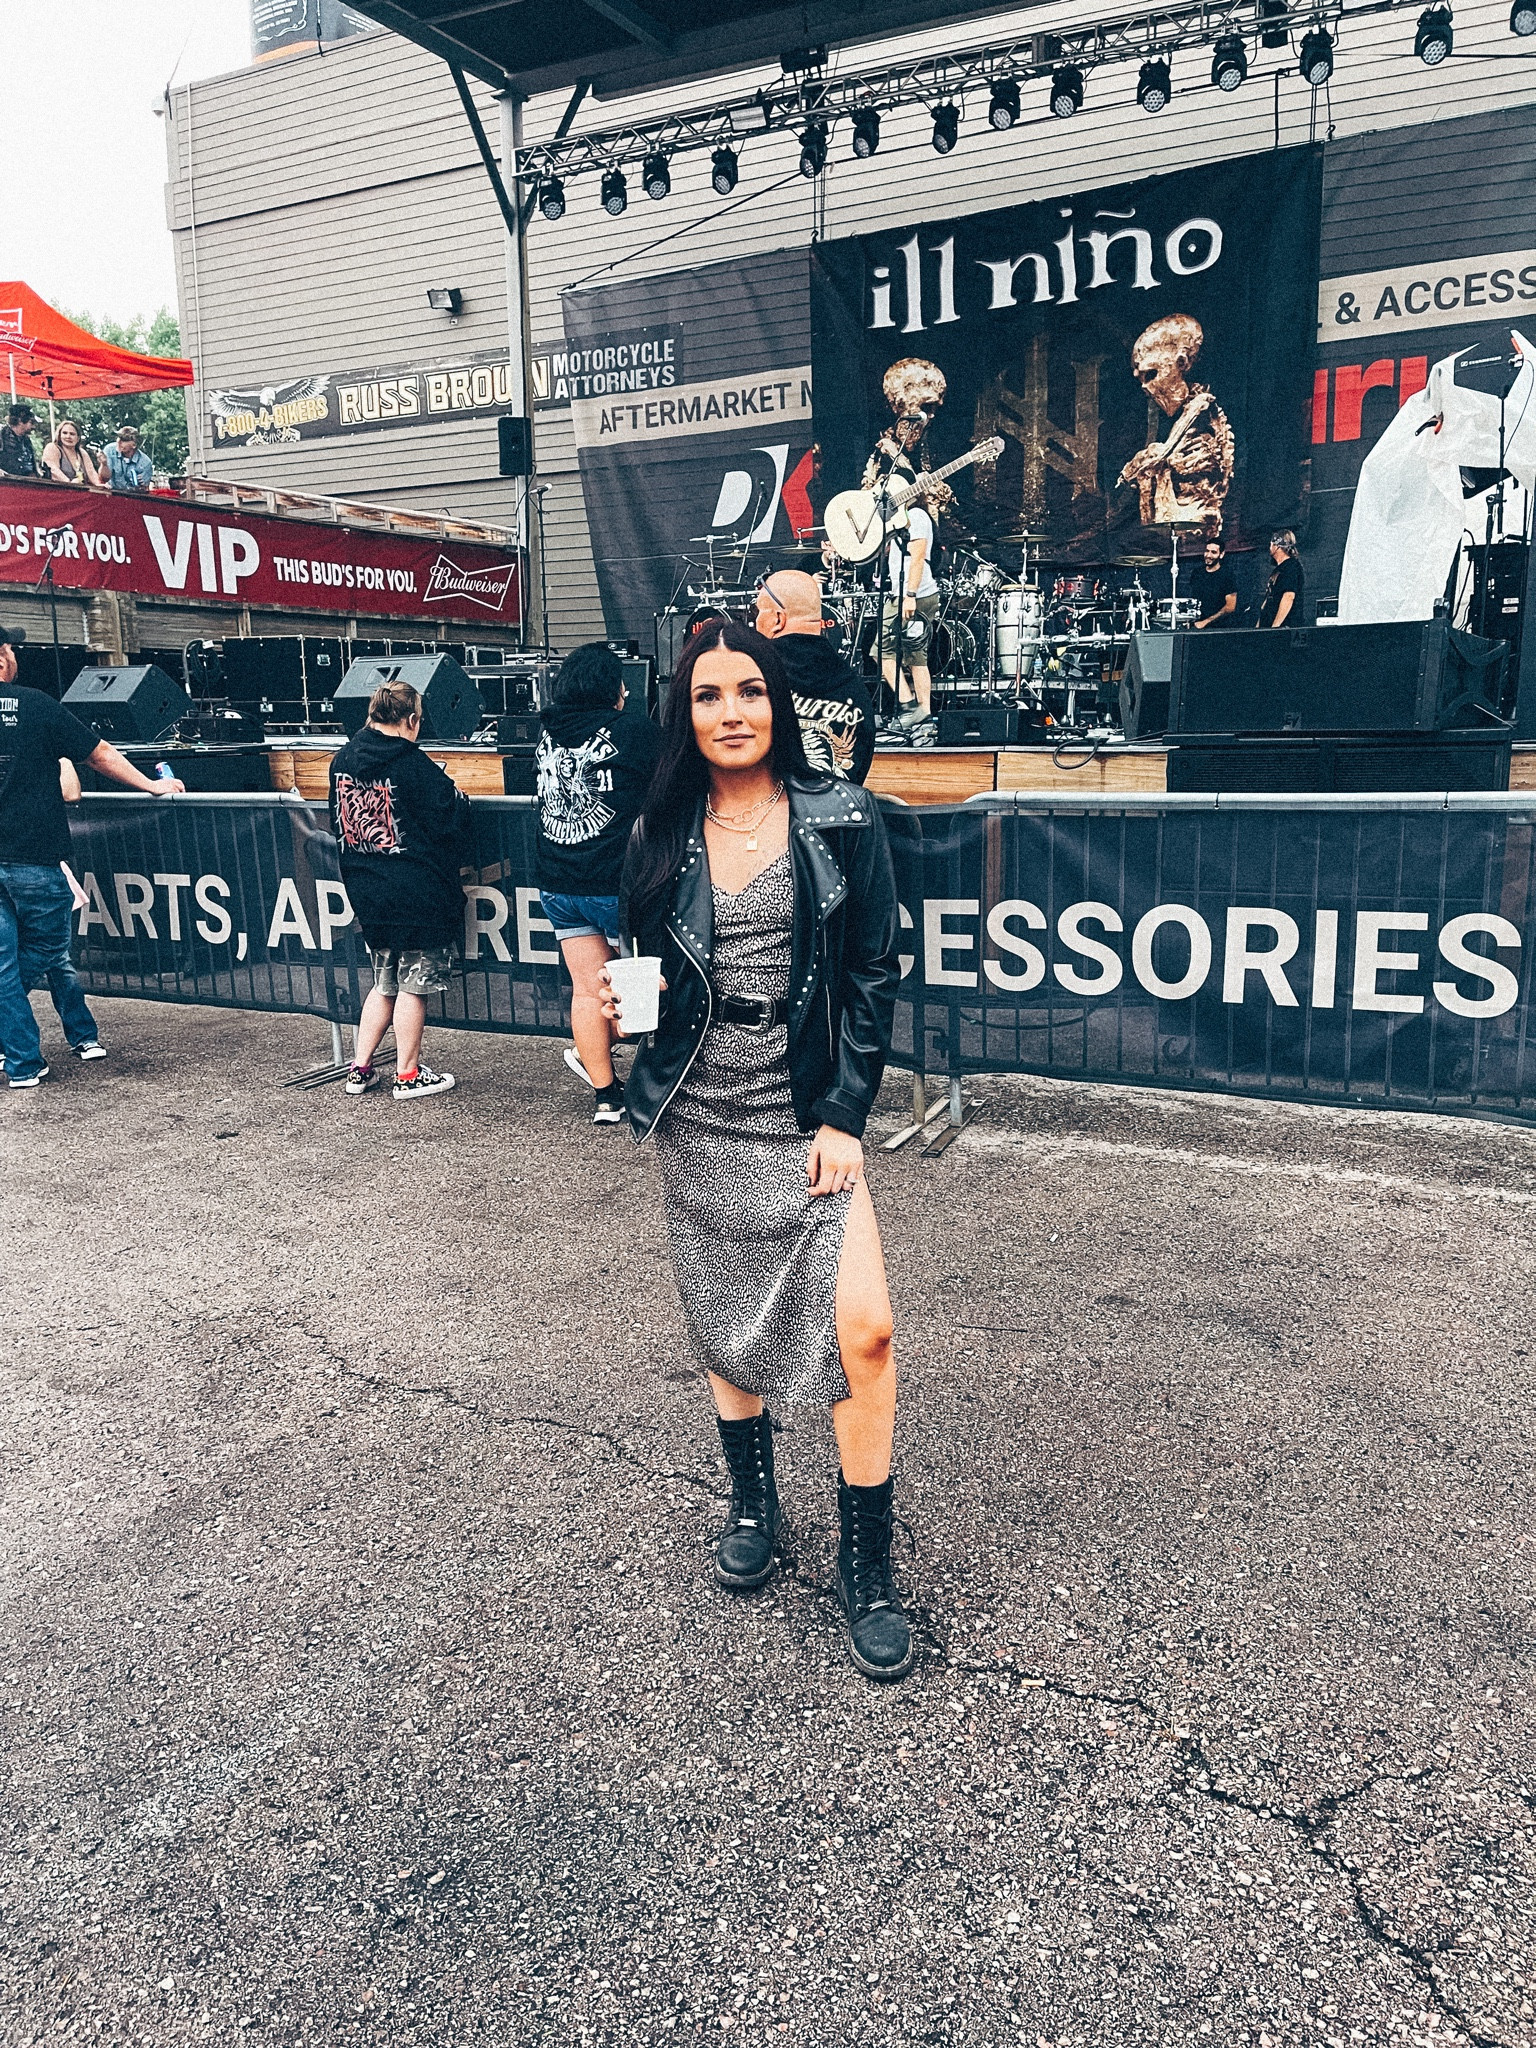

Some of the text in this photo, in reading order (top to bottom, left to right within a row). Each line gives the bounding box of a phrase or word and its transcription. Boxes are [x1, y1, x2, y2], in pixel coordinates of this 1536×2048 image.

[868, 208, 1223, 333] ill niño
[1335, 292, 1361, 325] &
[553, 339, 675, 376] MOTORCYCLE
[337, 375, 421, 426] RUSS
[555, 365, 675, 400] ATTORNEYS
[215, 396, 329, 439] 1-800-4-BIKERS
[600, 381, 792, 434] AFTERMARKET
[33, 527, 80, 558] FOR
[81, 532, 131, 564] YOU.
[142, 514, 260, 594] VIP
[273, 556, 417, 593] THIS BUD'S FOR YOU.
[430, 565, 507, 594] Budweiser
[78, 872, 249, 961] ARTS,
